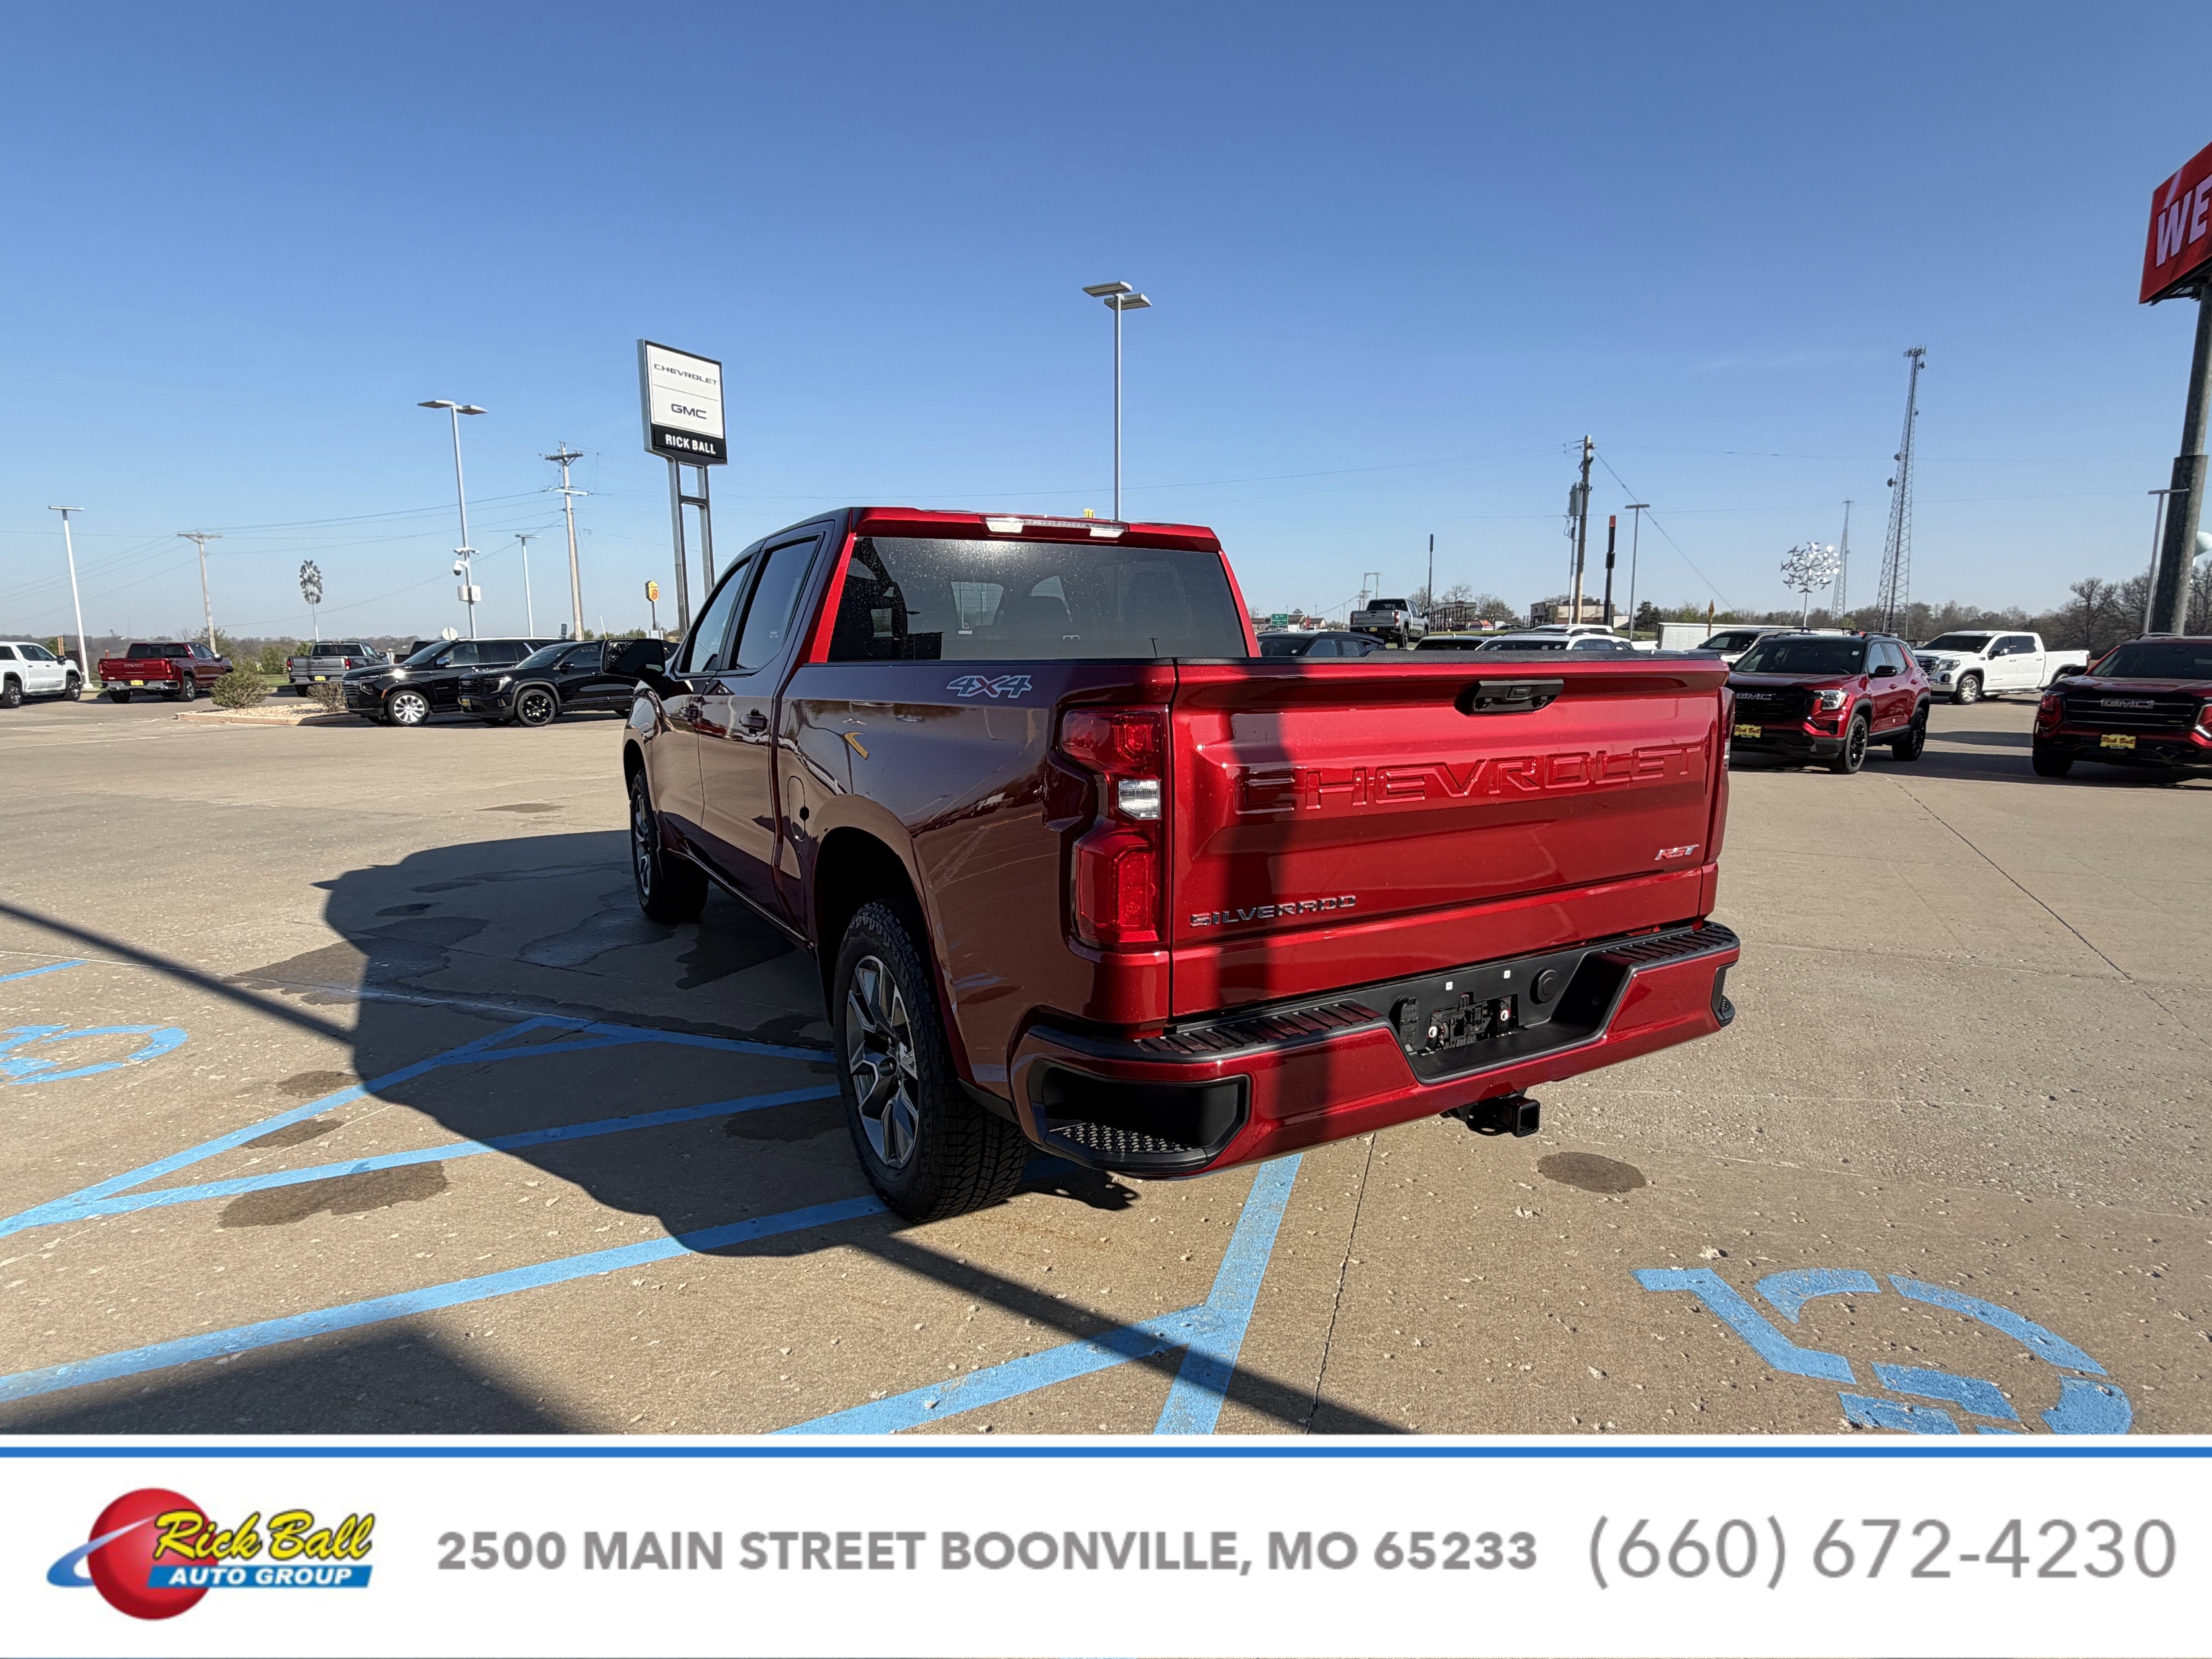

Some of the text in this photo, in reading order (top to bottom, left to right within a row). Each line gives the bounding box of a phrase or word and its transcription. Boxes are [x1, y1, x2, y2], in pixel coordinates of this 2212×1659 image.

[2156, 174, 2212, 268] WE
[654, 363, 717, 385] CHEVROLET
[671, 403, 707, 420] GMC
[665, 434, 716, 454] RICK BALL
[2102, 699, 2152, 709] GMC
[1235, 746, 1702, 814] CHEVROLET
[1654, 844, 1700, 860] RST
[1189, 895, 1356, 928] SILVERADO
